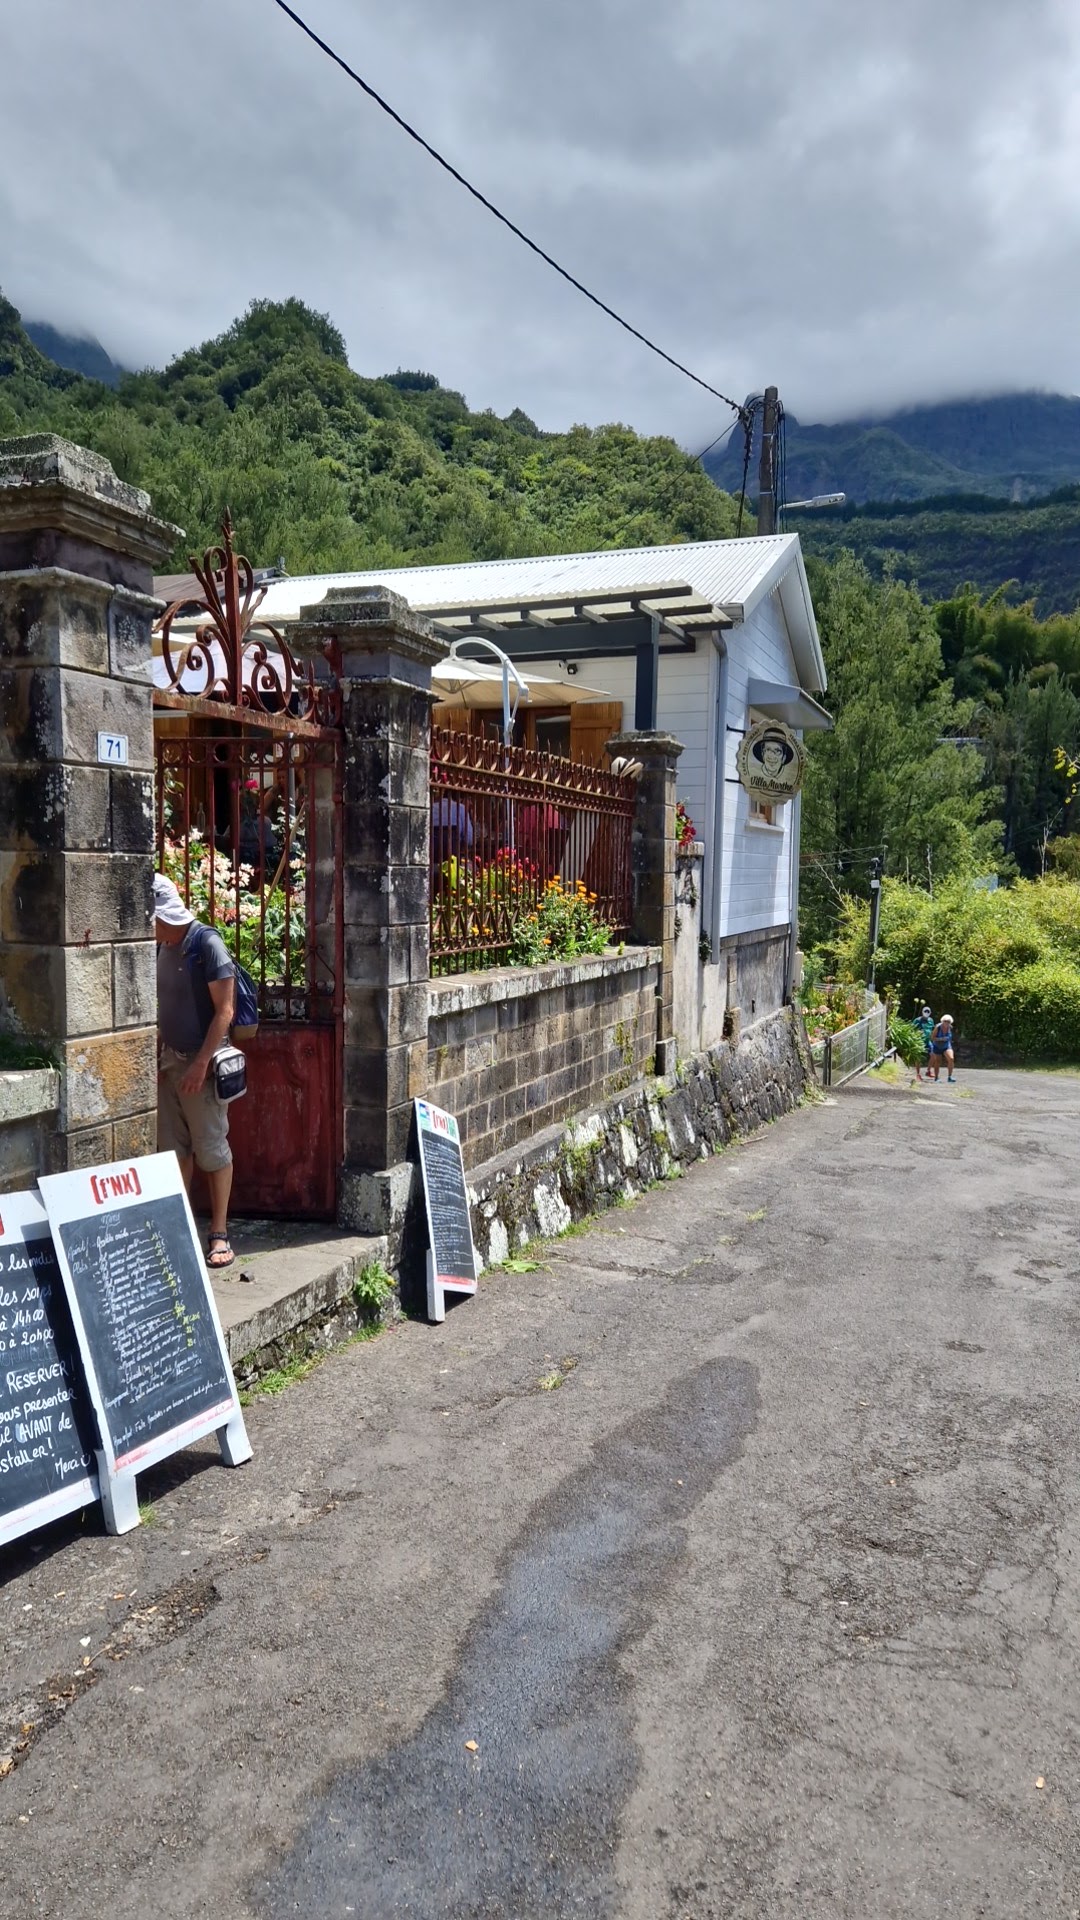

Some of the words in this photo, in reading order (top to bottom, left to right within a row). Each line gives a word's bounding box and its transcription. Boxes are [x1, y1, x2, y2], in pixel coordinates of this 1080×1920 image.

[107, 739, 121, 758] 71
[750, 775, 767, 789] Villa
[766, 779, 794, 791] Marthe
[12, 1309, 44, 1329] 14h00
[21, 1328, 55, 1346] 20h00
[19, 1415, 53, 1442] AVANT
[58, 1412, 72, 1432] de
